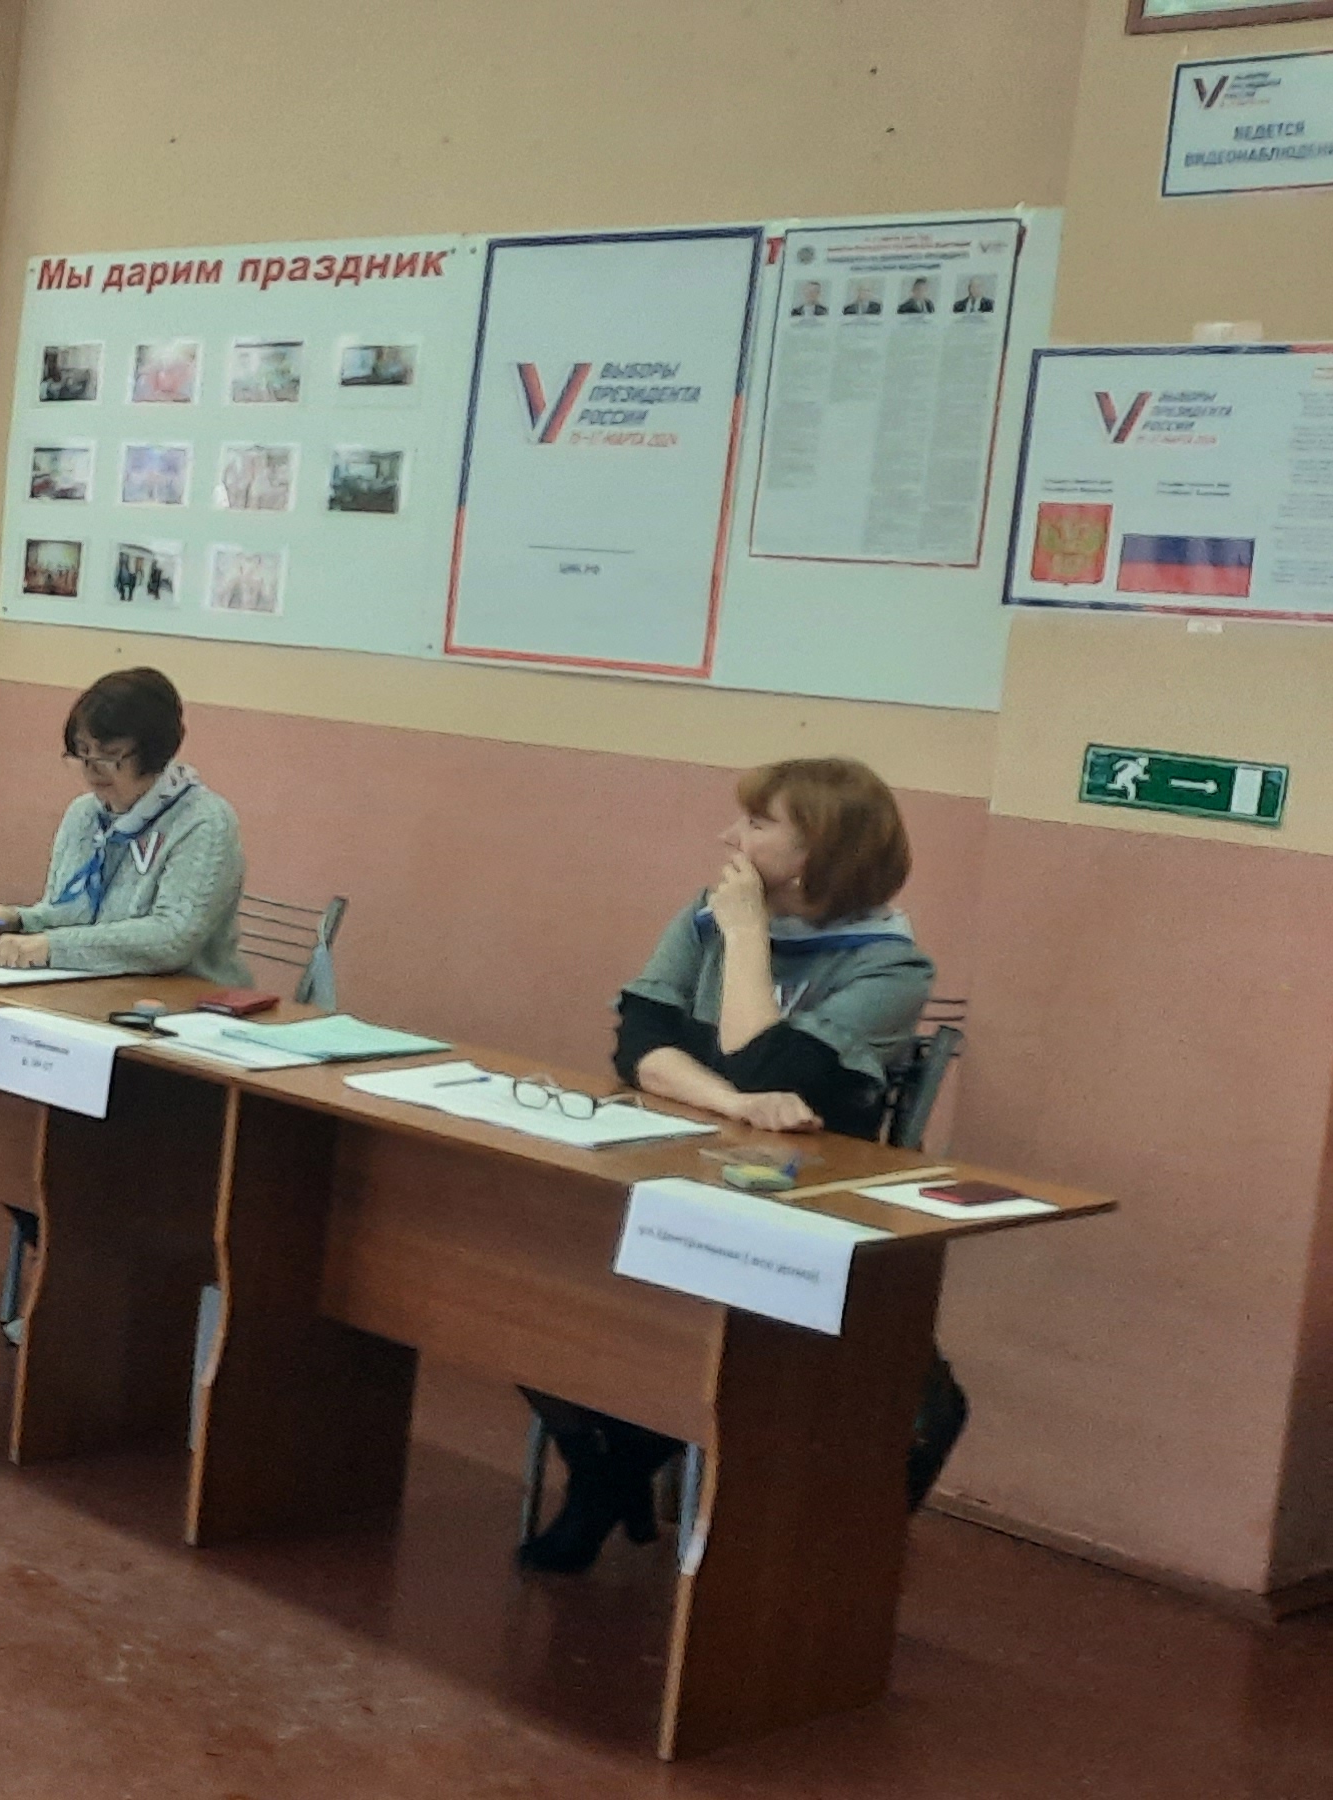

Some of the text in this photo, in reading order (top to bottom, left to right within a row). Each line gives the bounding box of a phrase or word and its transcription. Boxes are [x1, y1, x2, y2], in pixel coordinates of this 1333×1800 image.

[37, 250, 449, 294] Мы дарим праздник
[600, 362, 681, 379] ВЫБОРЫ
[589, 386, 701, 404] ПРЕЗИДЕНТА
[578, 409, 649, 425] РОССИИ
